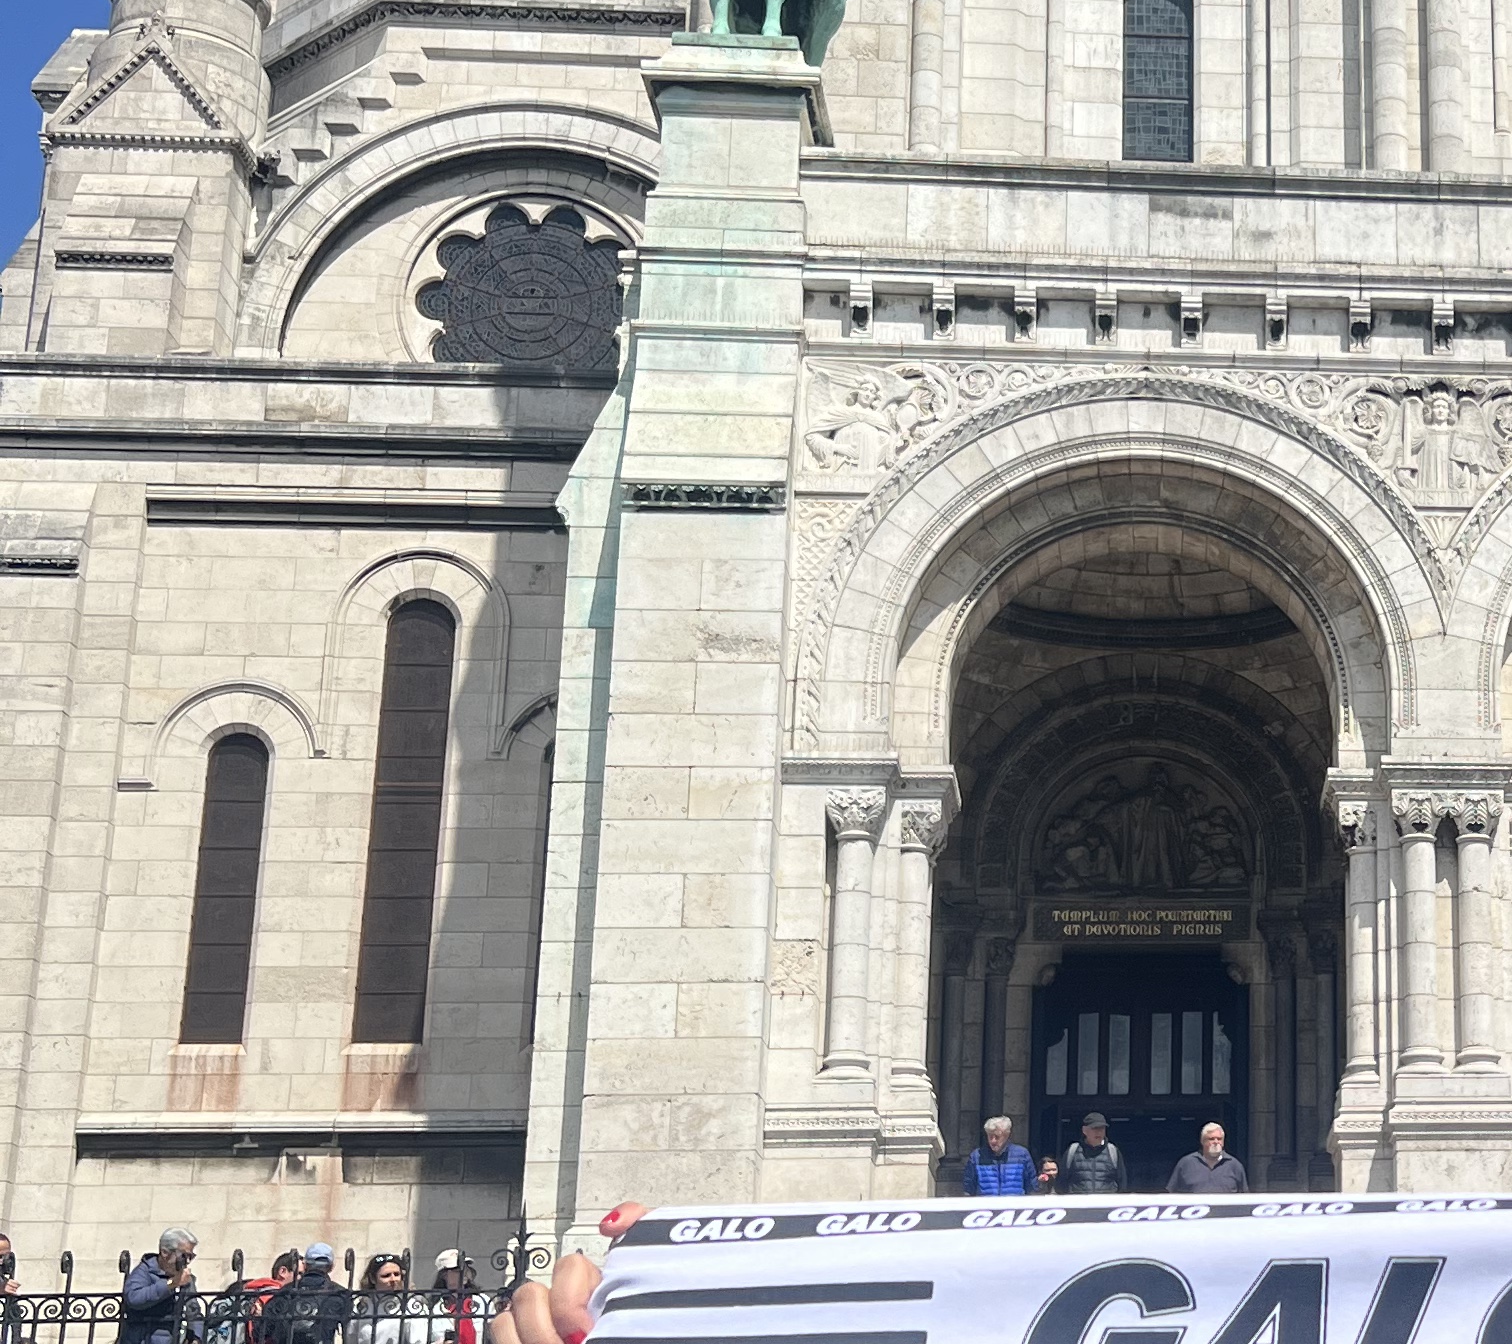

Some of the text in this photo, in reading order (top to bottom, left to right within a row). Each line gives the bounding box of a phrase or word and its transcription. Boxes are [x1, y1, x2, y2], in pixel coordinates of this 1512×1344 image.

[1052, 910, 1120, 922] TEMPLUM
[1127, 910, 1152, 922] HOC
[1063, 923, 1223, 936] ET DEVOTIONIS PIGNUS
[669, 1217, 775, 1242] GALO
[816, 1212, 922, 1236] GALO
[962, 1208, 1067, 1229] GALO
[1107, 1204, 1209, 1223] GALO
